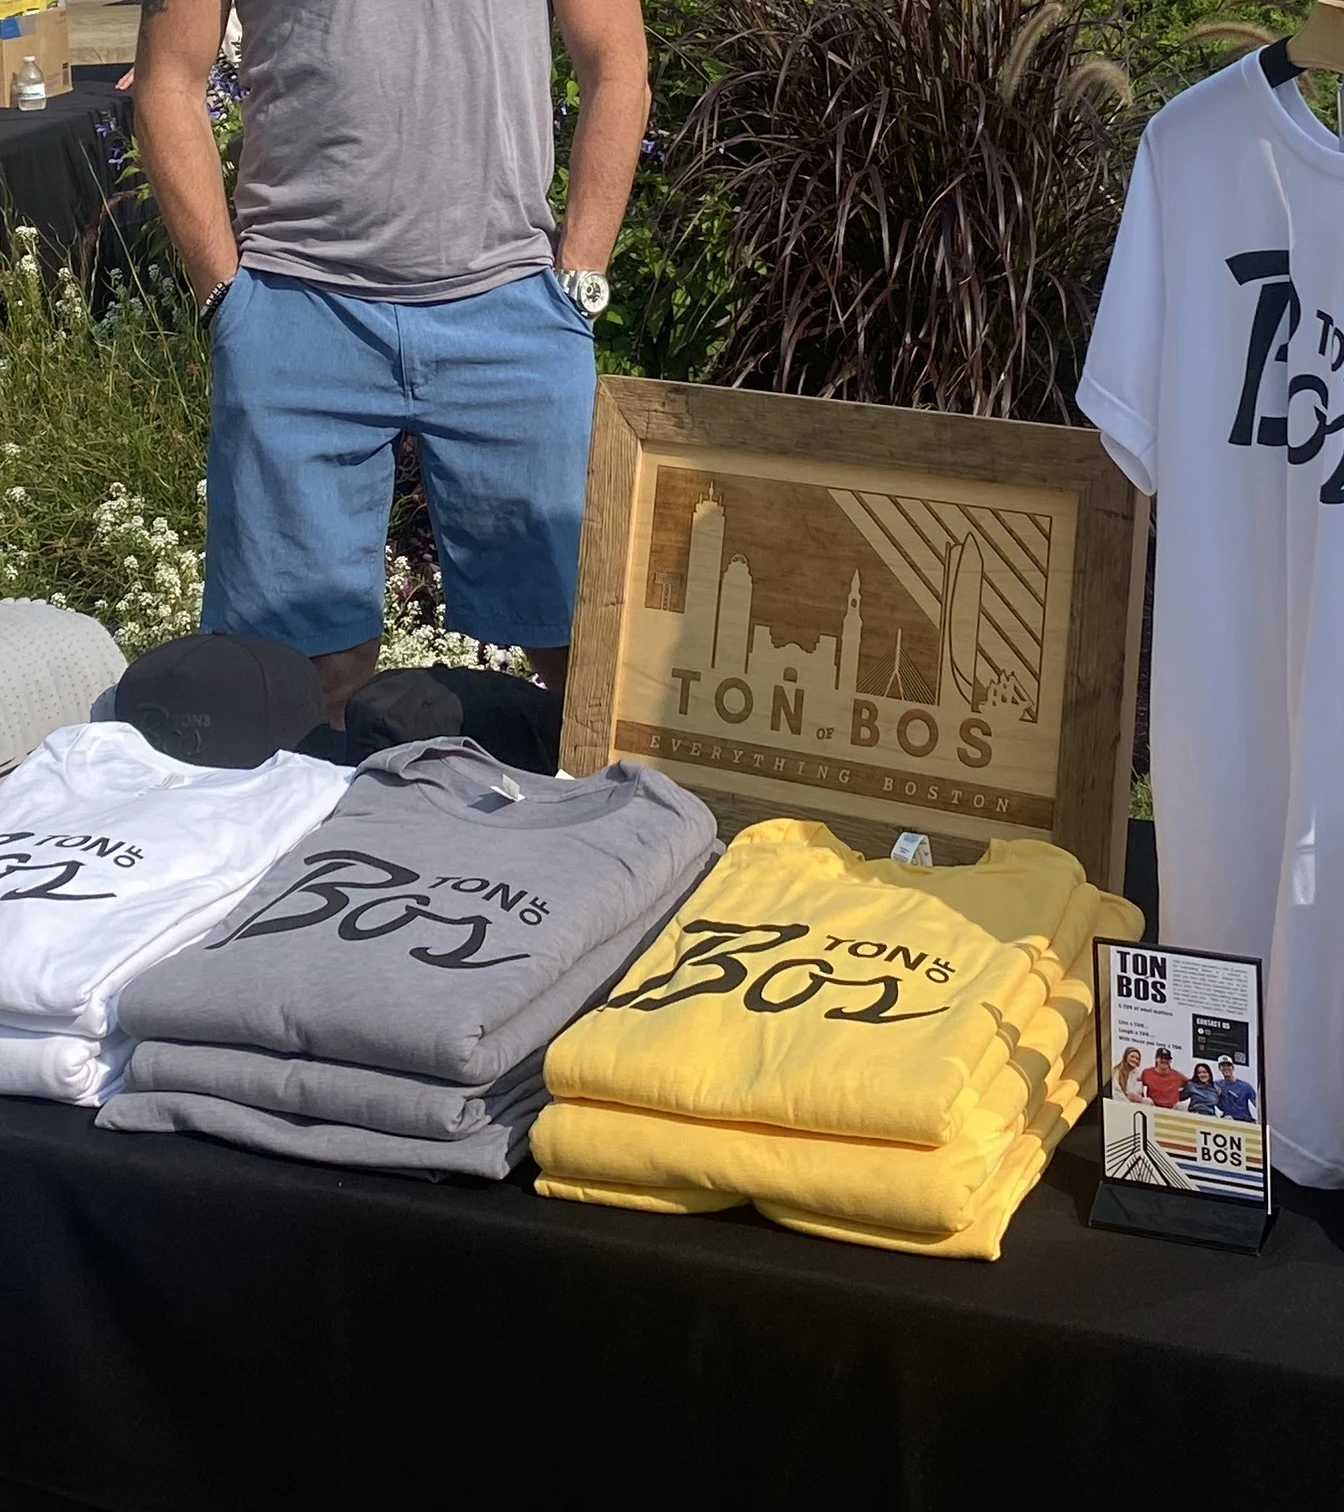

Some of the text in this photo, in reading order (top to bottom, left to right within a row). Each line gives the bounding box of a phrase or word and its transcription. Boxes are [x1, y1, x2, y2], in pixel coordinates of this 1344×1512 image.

[671, 667, 993, 769] TON OF BOS
[649, 734, 1011, 815] EVERYTHING BOSTON
[34, 832, 145, 869] TON OF
[206, 849, 531, 969] Bos
[434, 875, 551, 927] TON OF
[604, 919, 951, 1024] Bos
[823, 934, 957, 984] TON OF
[1116, 950, 1167, 980] TON
[1117, 975, 1167, 1004] BOS
[1200, 1131, 1241, 1151] TON
[1201, 1147, 1242, 1167] BOS
